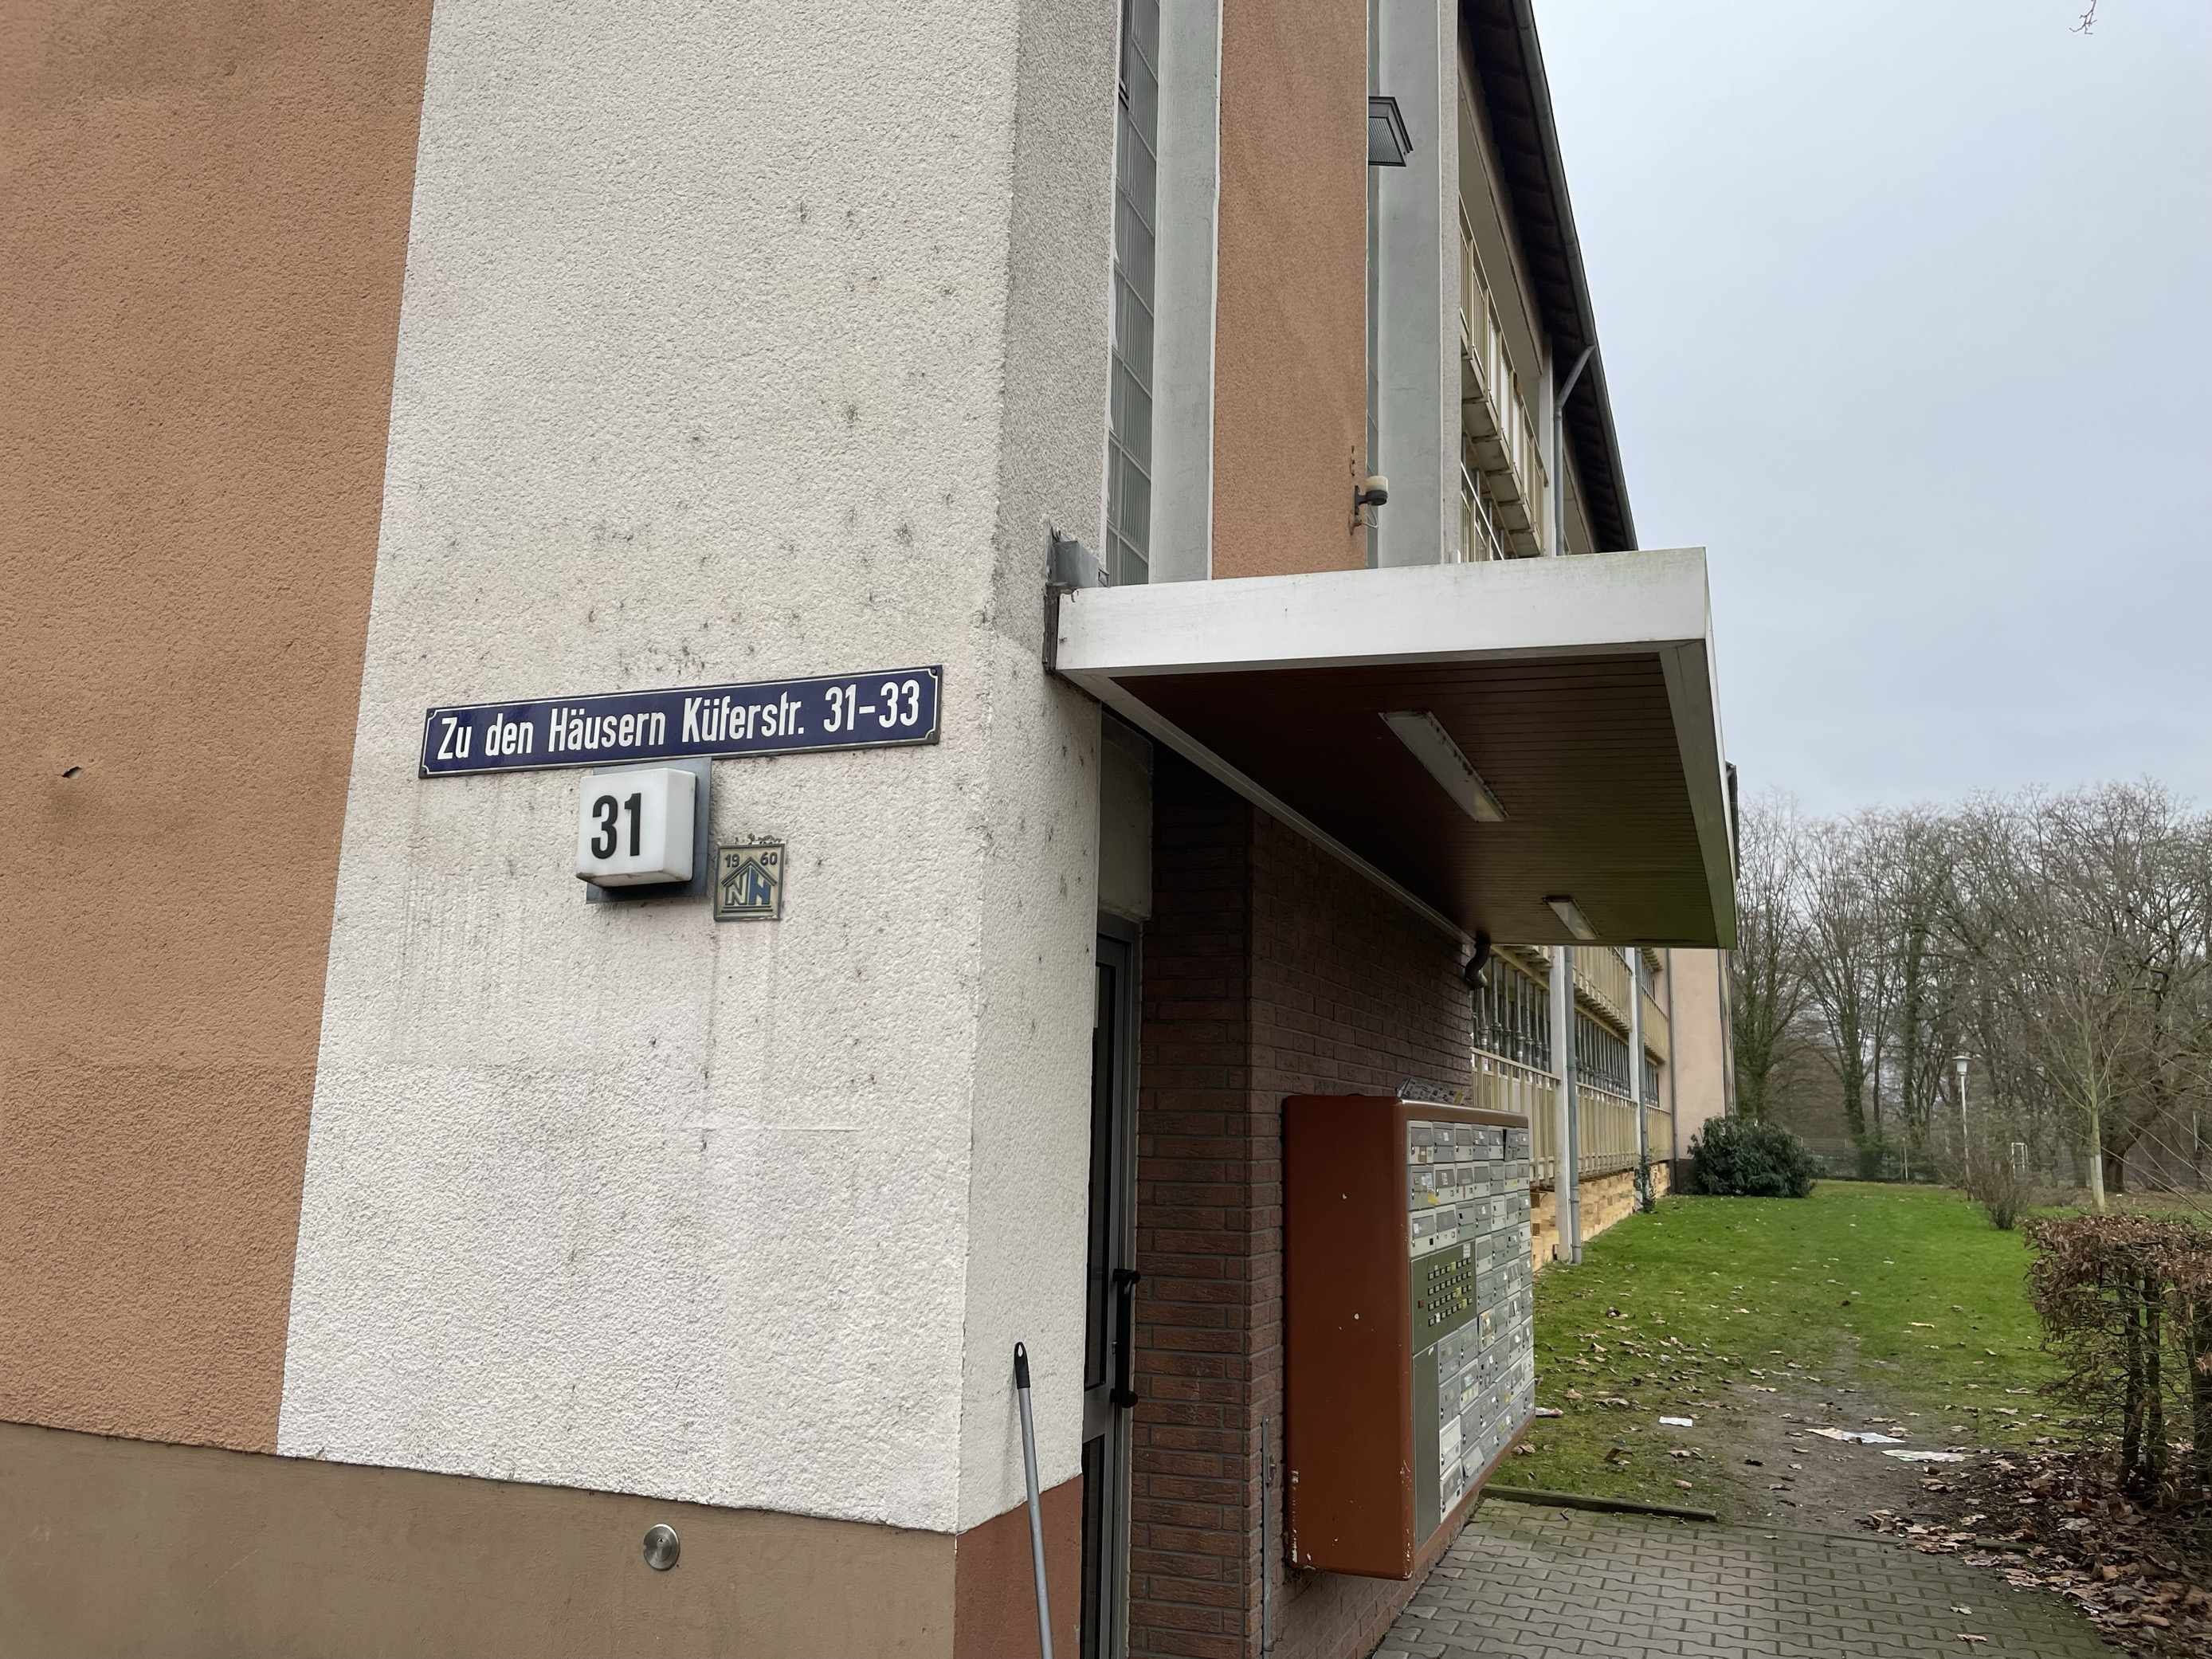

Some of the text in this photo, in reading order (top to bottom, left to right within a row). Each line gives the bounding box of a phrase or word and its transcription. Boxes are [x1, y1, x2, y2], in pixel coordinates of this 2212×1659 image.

[437, 679, 920, 760] Zu den Häusern Küferstr. 31-33
[590, 792, 641, 860] 31
[725, 852, 778, 867] 19 60
